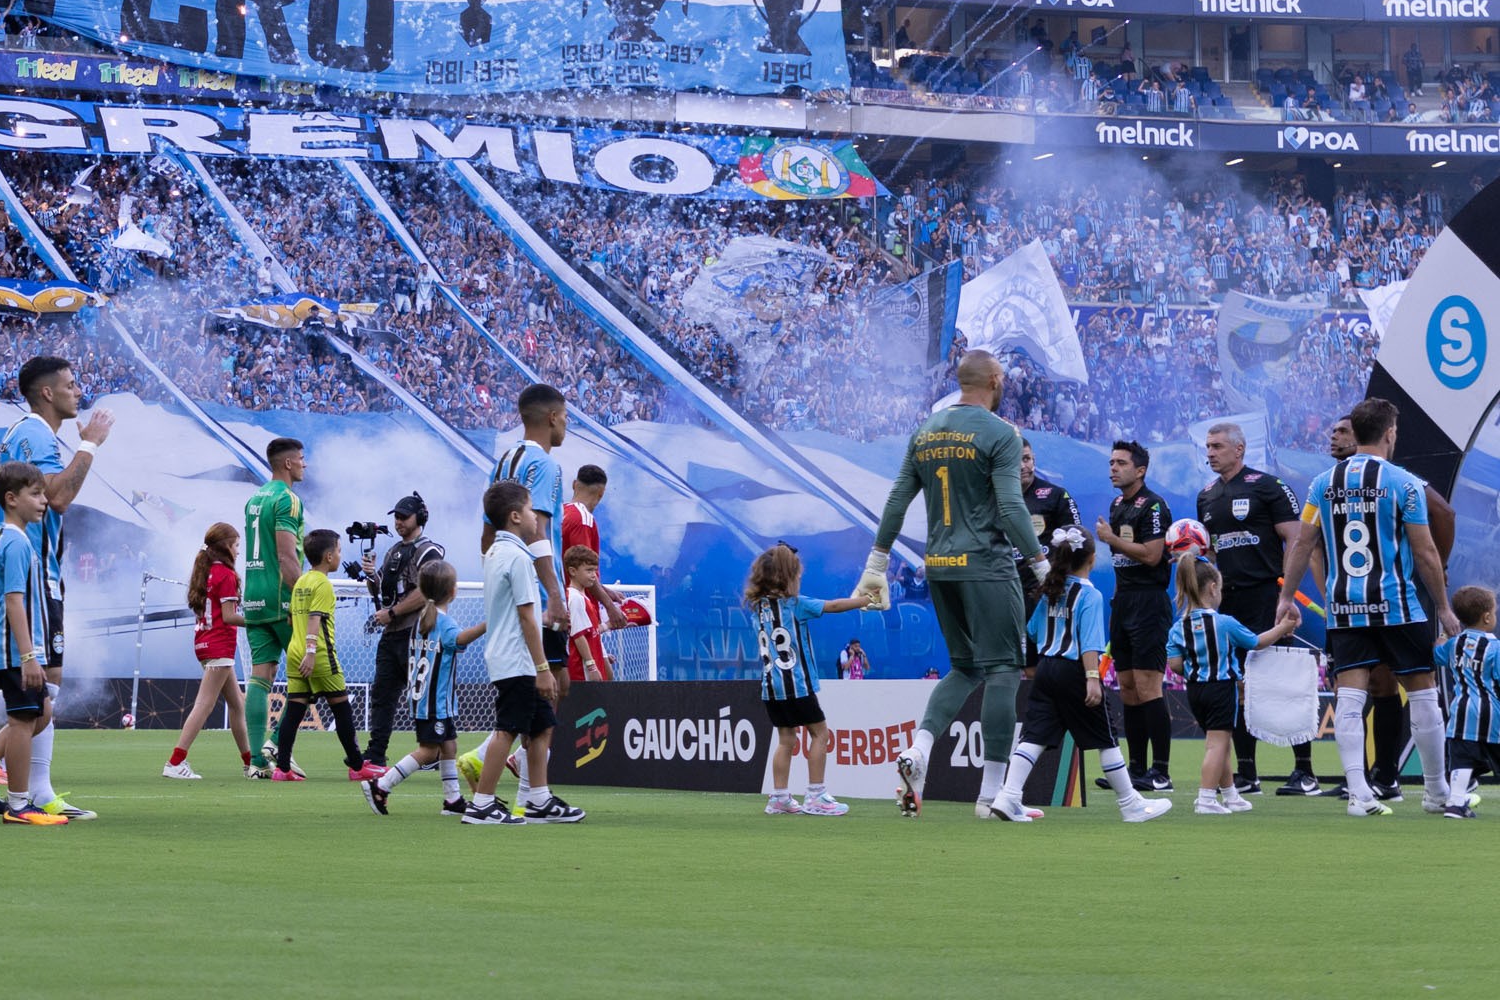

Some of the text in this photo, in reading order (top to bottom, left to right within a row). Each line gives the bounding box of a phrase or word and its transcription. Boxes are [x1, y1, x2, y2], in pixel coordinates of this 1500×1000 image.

[16, 57, 78, 82] Trilegal
[99, 62, 160, 87] Trilegal
[764, 61, 812, 84] 1990
[1099, 120, 1195, 147] melnick
[1310, 131, 1359, 152] POA
[1408, 129, 1500, 153] melnic
[927, 430, 975, 444] banrisul
[916, 446, 976, 463] WEVERTON
[935, 466, 952, 527] 1
[1337, 487, 1388, 499] banrisul
[1333, 502, 1376, 516] ARTHUR
[1342, 520, 1374, 578] 8
[1330, 599, 1390, 616] Unimed
